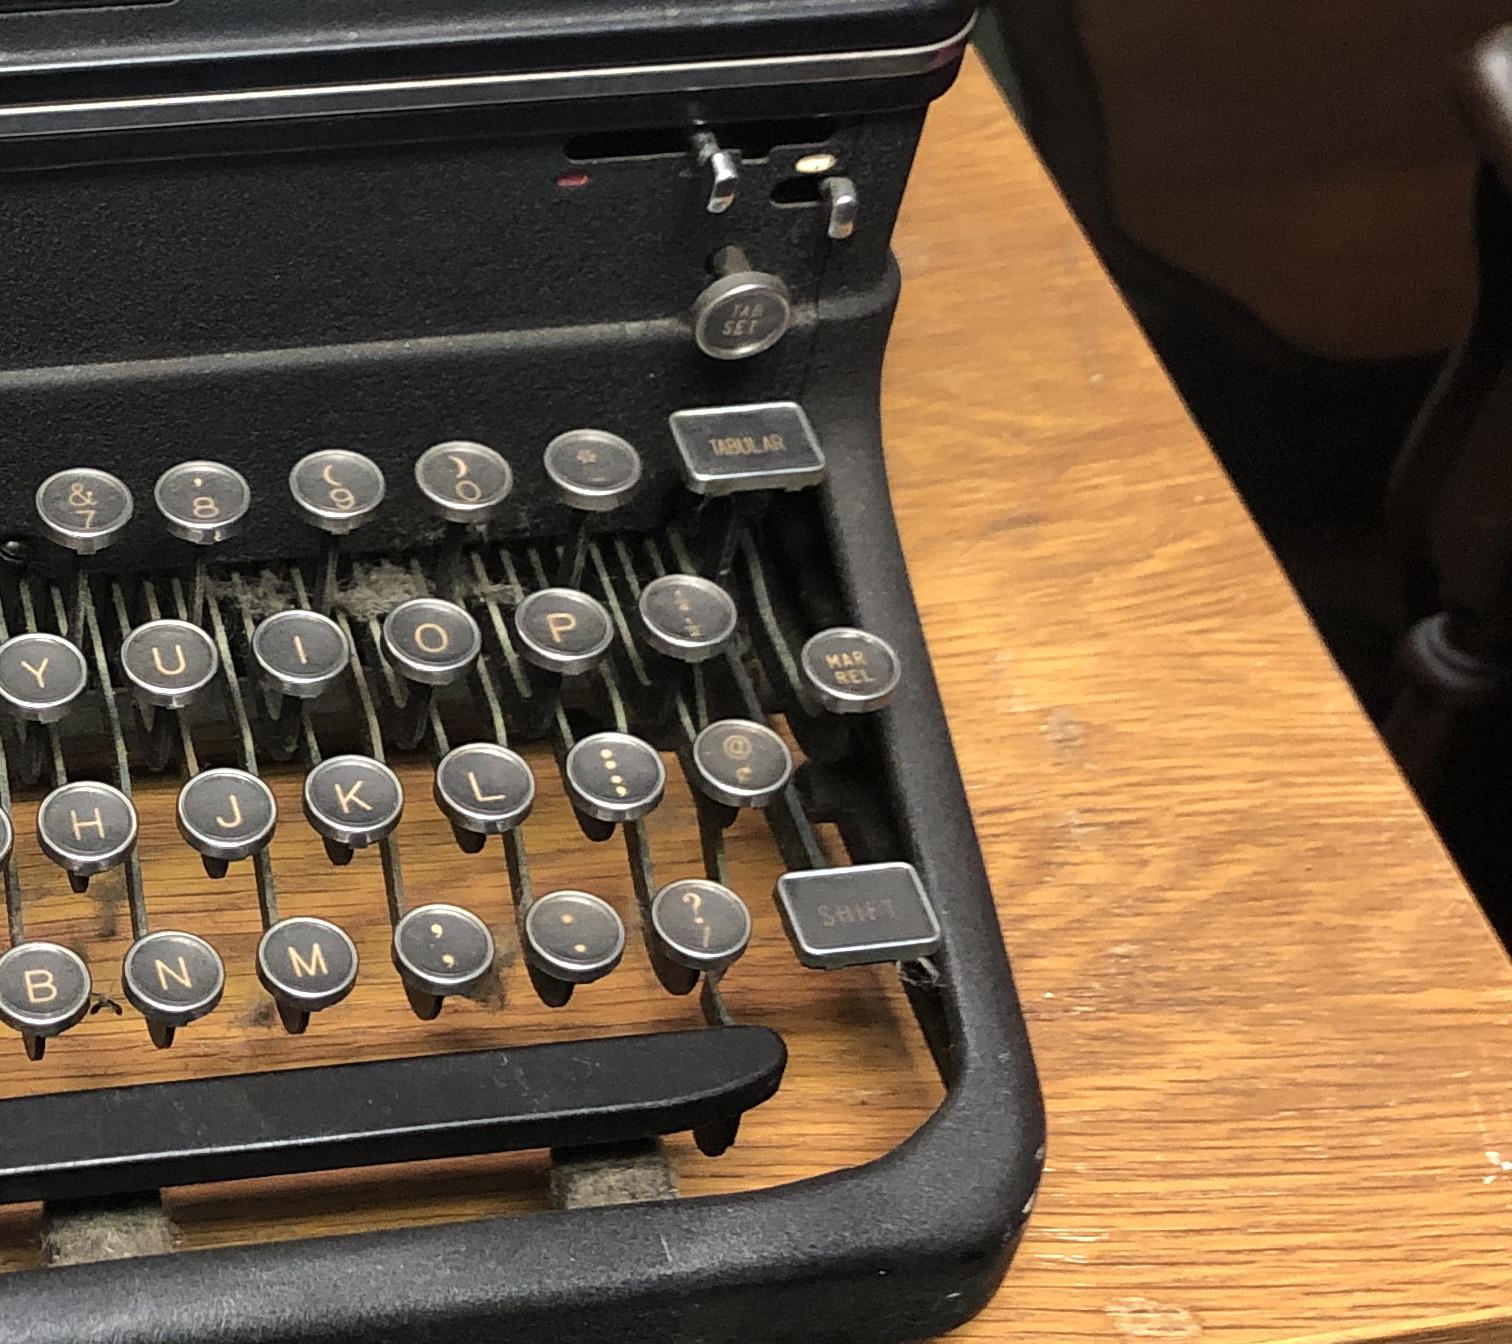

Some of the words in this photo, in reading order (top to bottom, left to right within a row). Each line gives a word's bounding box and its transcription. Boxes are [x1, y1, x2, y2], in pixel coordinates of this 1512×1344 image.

[709, 433, 785, 456] TABULAR
[68, 482, 98, 507] &
[193, 496, 220, 519] 8
[331, 487, 355, 511] 9
[76, 510, 98, 532] 7
[414, 622, 449, 653] O
[545, 612, 577, 643] P
[20, 657, 49, 689] Y
[151, 644, 186, 675] U
[825, 651, 865, 669] MAR
[833, 669, 875, 686] REL
[334, 780, 372, 814] K
[467, 771, 506, 802] L
[70, 807, 105, 841] H
[216, 794, 243, 828] J
[683, 892, 701, 923] ?
[154, 956, 193, 991] N
[287, 942, 329, 978] M
[23, 968, 58, 1004] B
